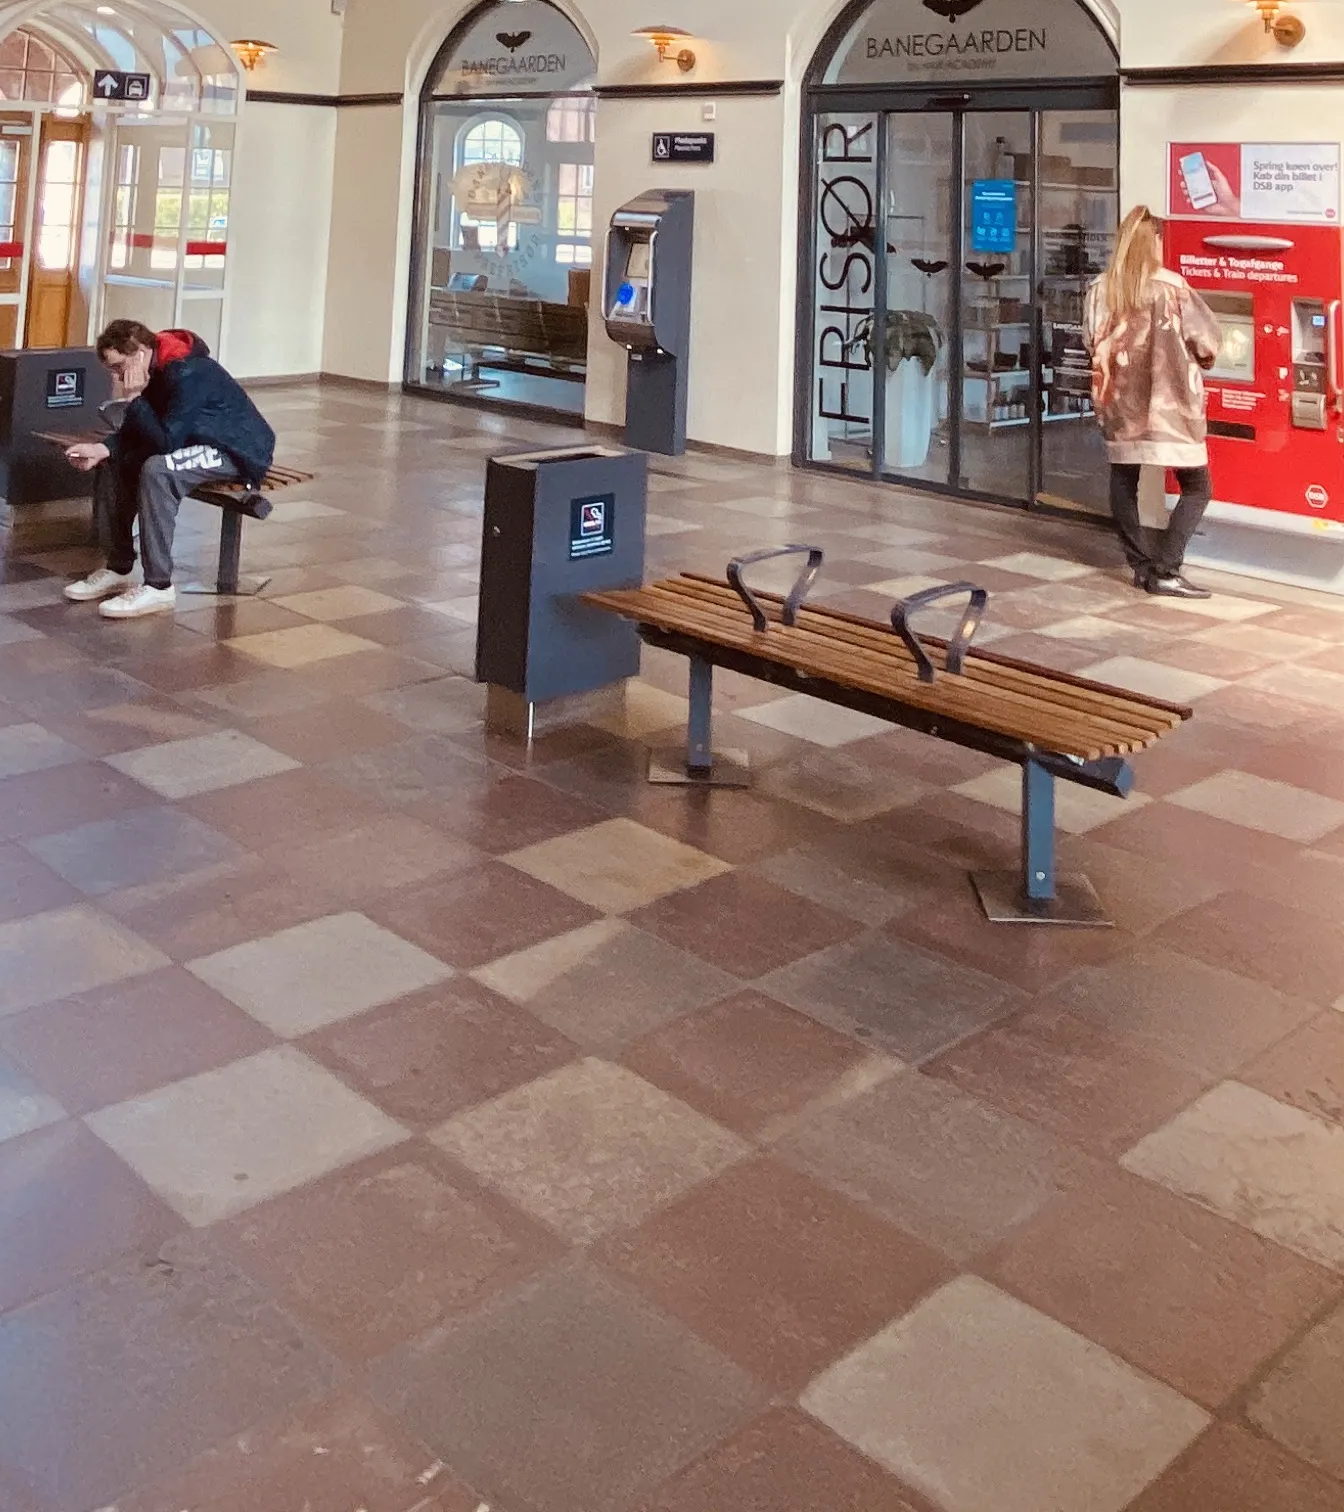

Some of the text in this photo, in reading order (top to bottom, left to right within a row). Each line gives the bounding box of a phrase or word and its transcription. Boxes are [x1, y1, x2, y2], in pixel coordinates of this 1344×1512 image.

[866, 28, 1047, 59] BANEGAARDEN
[461, 54, 566, 76] BANEGAARDEN
[1253, 161, 1284, 172] Spring
[1312, 162, 1338, 171] over!
[1274, 172, 1290, 181] din
[1292, 172, 1317, 181] billet
[1253, 182, 1294, 192] DSB app
[1180, 255, 1217, 266] Billetter
[1219, 257, 1227, 266] &
[819, 121, 873, 424] FRISØR
[1181, 267, 1298, 283] Tickets & Train departures
[1308, 491, 1326, 502] DSB
